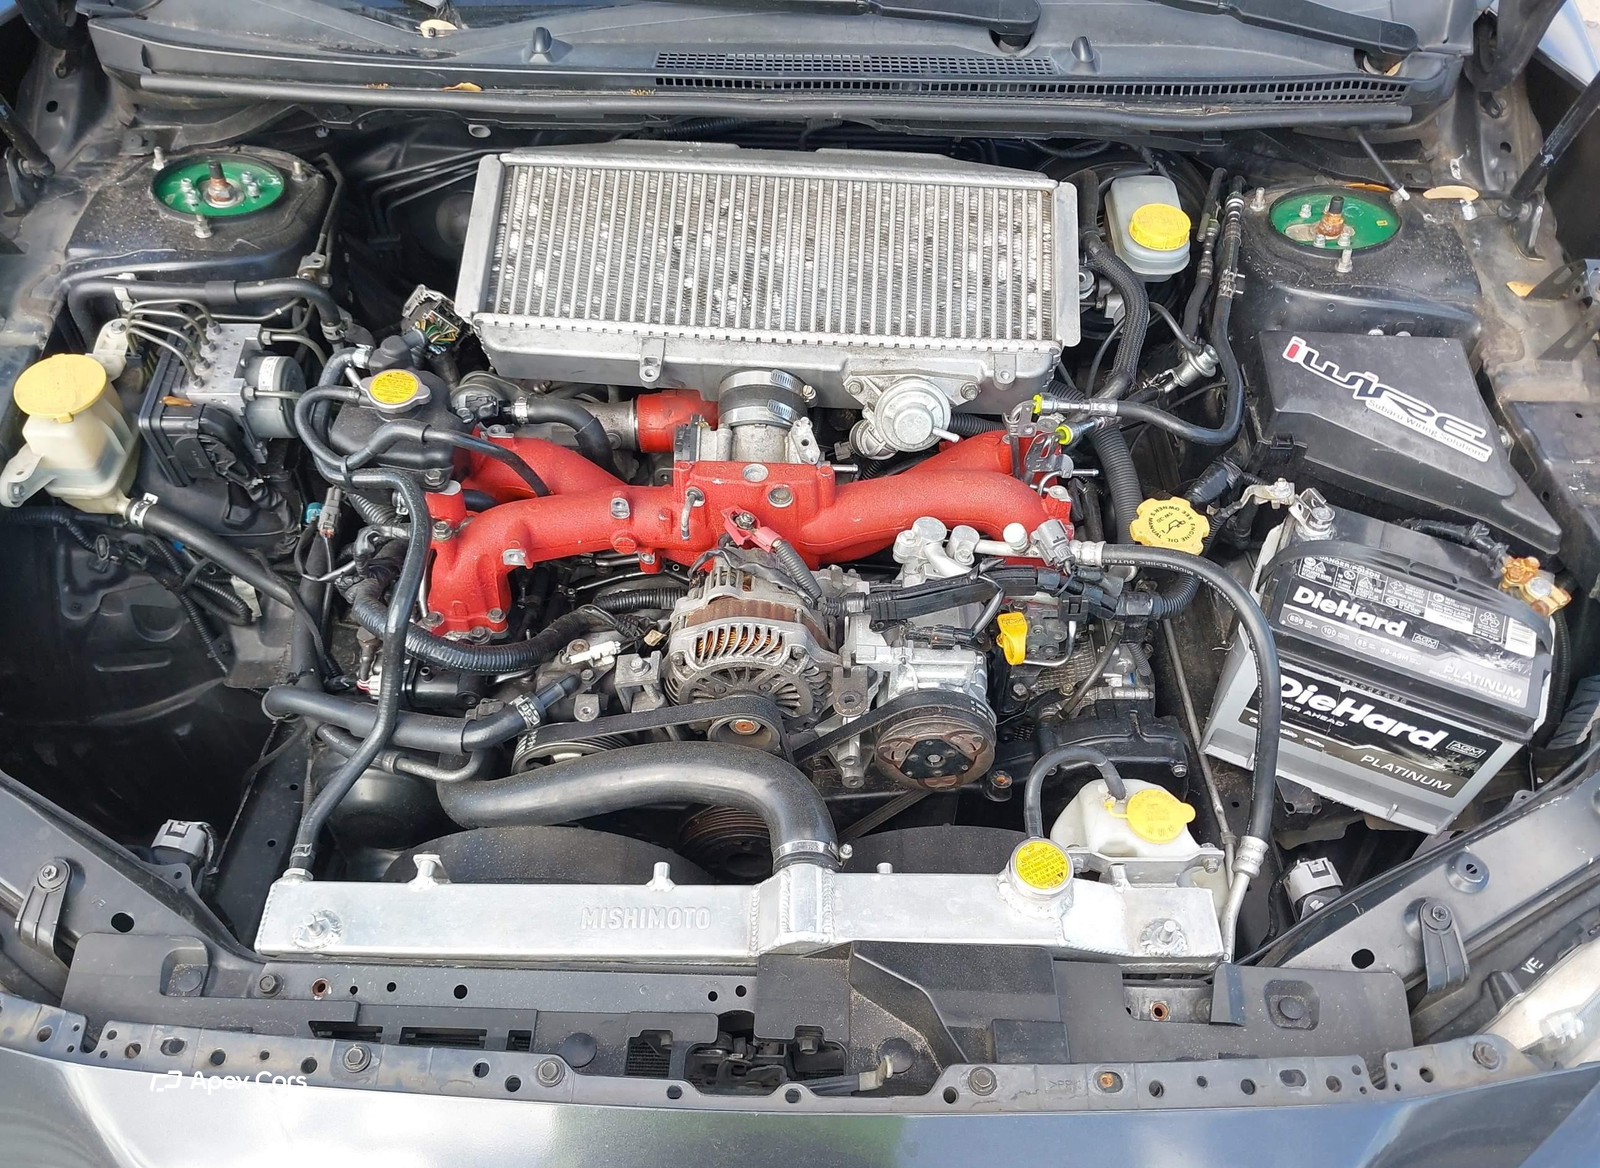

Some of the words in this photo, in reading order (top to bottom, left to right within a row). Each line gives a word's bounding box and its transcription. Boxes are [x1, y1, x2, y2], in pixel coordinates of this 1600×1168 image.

[1367, 399, 1404, 421] Subaru
[1406, 417, 1438, 438] Wiring
[1439, 432, 1487, 460] Solutions
[1181, 510, 1194, 521] SEE
[1147, 517, 1162, 540] MANUAL
[1181, 522, 1196, 543] ENGINE
[1292, 585, 1408, 638] DieHard
[1443, 665, 1523, 699] PLATINUM
[1281, 675, 1449, 750] DieHard
[1303, 709, 1345, 727] AHEAD
[1452, 741, 1483, 755] AGM
[1360, 754, 1453, 791] PLATINUM
[580, 906, 712, 930] MISHIMOTO
[1521, 956, 1545, 974] VE
